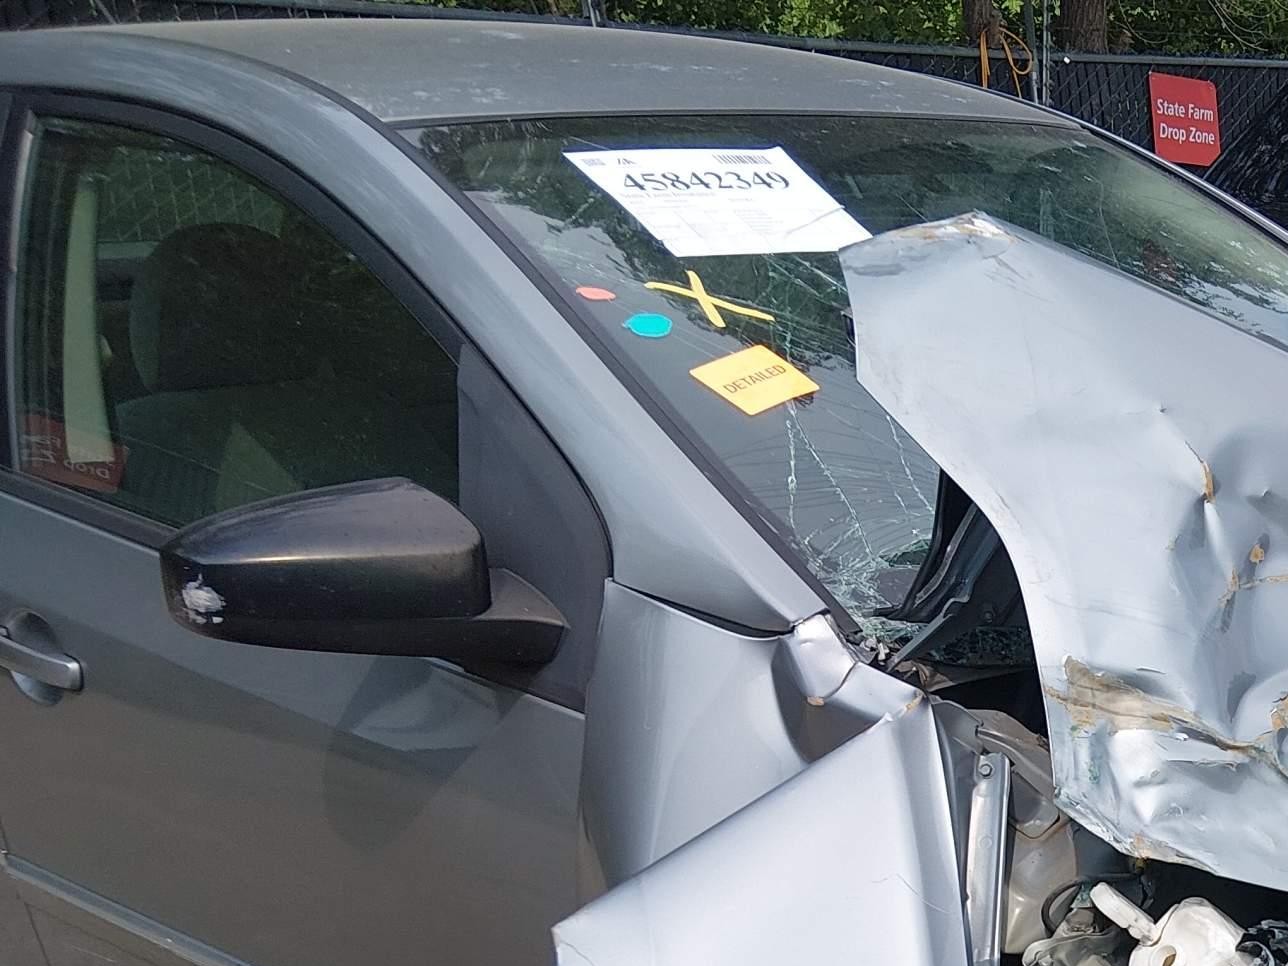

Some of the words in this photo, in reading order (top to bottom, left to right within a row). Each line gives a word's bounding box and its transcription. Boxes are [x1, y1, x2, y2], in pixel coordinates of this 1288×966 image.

[1156, 98, 1185, 117] State
[1188, 103, 1214, 121] Farm
[1159, 122, 1186, 144] Drop
[1189, 127, 1215, 144] Zone
[623, 170, 791, 192] 45842349
[722, 364, 787, 394] DETAILED
